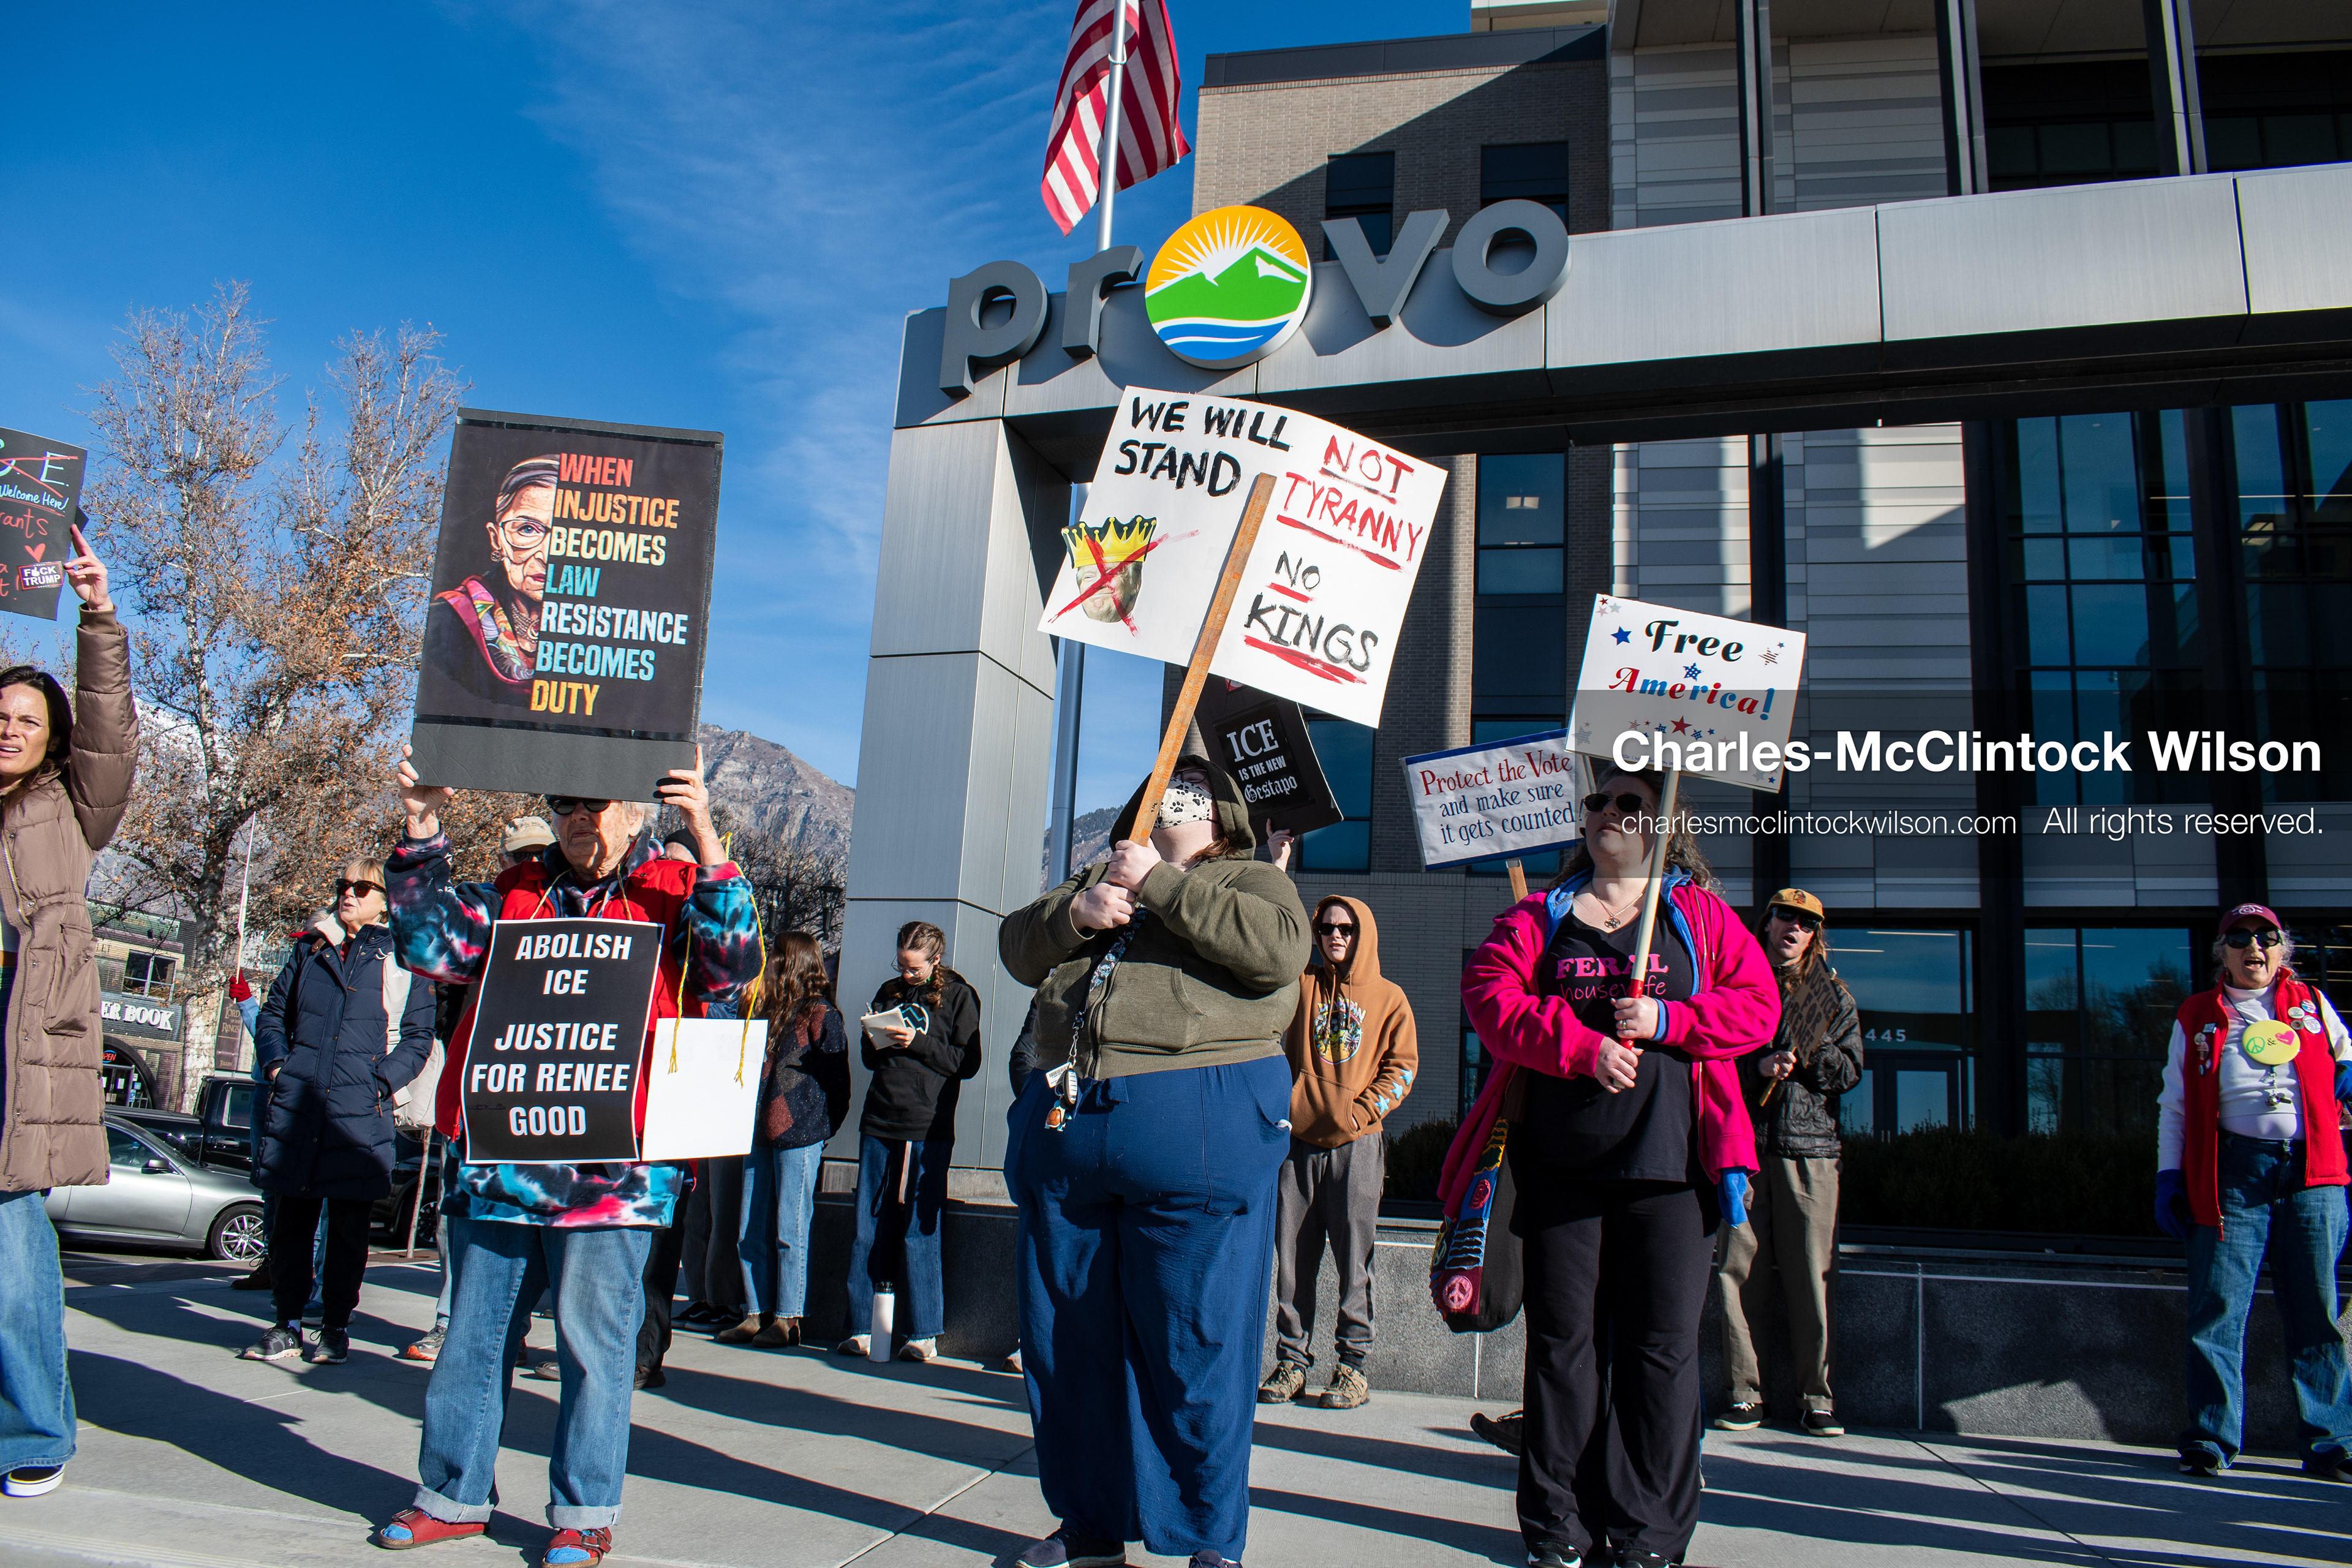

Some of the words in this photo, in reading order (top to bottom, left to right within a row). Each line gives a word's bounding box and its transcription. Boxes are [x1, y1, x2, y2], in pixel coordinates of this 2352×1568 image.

[1131, 396, 1189, 432] WE
[1204, 405, 1293, 452] WILL
[560, 453, 633, 488] WHEN
[1114, 439, 1242, 497] STAND
[1322, 435, 1415, 494] NOT
[42, 491, 69, 513] Here!
[554, 489, 680, 529] INJUSTICE
[1285, 472, 1424, 562] TYRANNY
[549, 526, 668, 566] BECOMES
[1246, 527, 1257, 545] SKU#
[23, 574, 61, 586] TRUMP
[545, 563, 601, 598] LAW
[1275, 551, 1321, 592] NO
[539, 601, 689, 646] RESISTANCE
[1215, 606, 1229, 631] PAINTS
[1243, 592, 1379, 673] KINGS
[1206, 631, 1219, 657] FINEST
[1645, 620, 1743, 663] Free
[535, 640, 655, 681] BECOMES
[1197, 673, 1205, 683] OF
[1200, 657, 1210, 671] THE
[530, 679, 600, 716] DUTY
[1188, 683, 1201, 706] HOME
[1608, 666, 1776, 722] America!
[1227, 718, 1280, 763] ICE
[1154, 780, 1166, 800] THE
[1161, 753, 1176, 780] HOME
[1170, 722, 1187, 752] DEPOT
[1238, 769, 1250, 782] IS
[1248, 761, 1267, 778] THE
[1265, 755, 1287, 772] NEW
[1419, 766, 1493, 796] Protect
[1498, 758, 1527, 782] the
[1525, 749, 1573, 778] Vote
[1245, 775, 1298, 803] Gestapo
[1439, 795, 1469, 818] and
[1476, 788, 1521, 813] make
[1528, 783, 1564, 802] sure
[1441, 824, 1456, 844] it
[1458, 818, 1494, 846] gets
[1501, 799, 1585, 834] counted!
[514, 933, 632, 961] ABOLISH
[543, 969, 589, 995] ICE
[1560, 975, 1667, 1001] housefe
[1805, 962, 1838, 1022] JUSTICE
[123, 1005, 175, 1031] BOOK
[221, 1022, 240, 1034] RINGS
[1787, 1001, 1814, 1056] RENEE
[1800, 991, 1823, 1033] FOR
[494, 1023, 619, 1051] JUSTICE
[1865, 1028, 1906, 1042] 445
[470, 1063, 528, 1093] FOR
[536, 1063, 631, 1093] RENEE
[509, 1105, 587, 1136] GOOD
